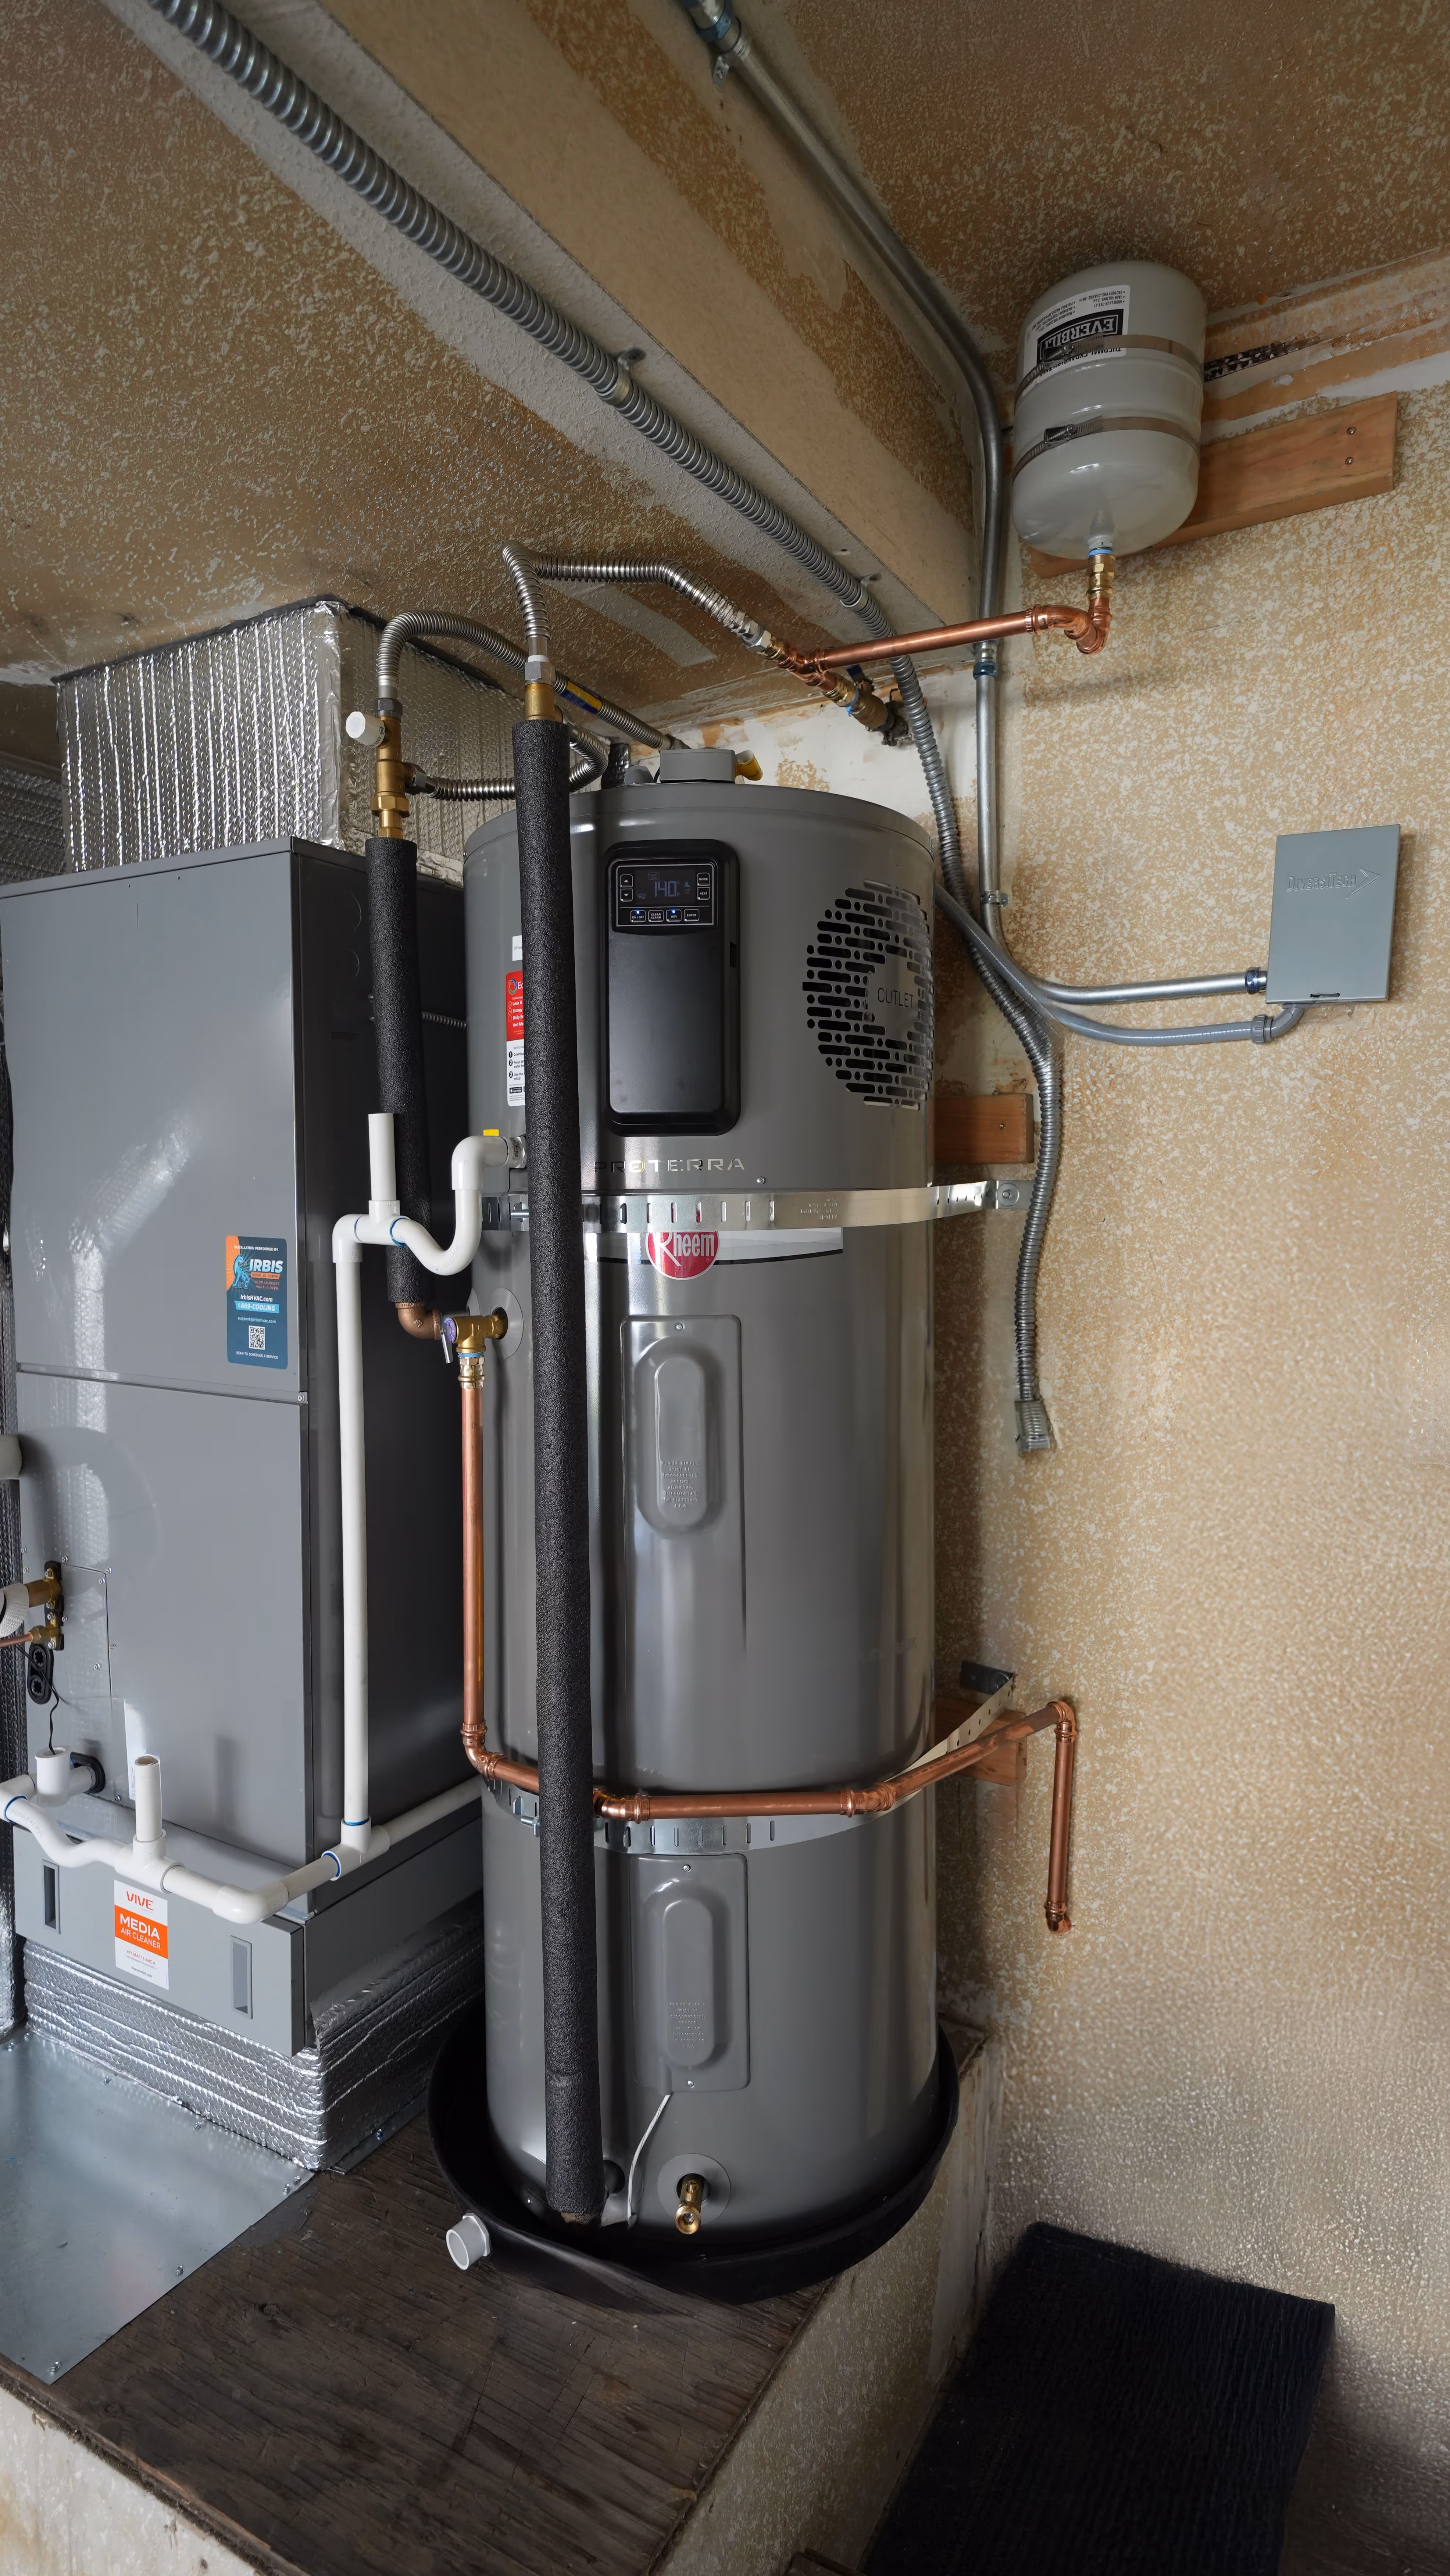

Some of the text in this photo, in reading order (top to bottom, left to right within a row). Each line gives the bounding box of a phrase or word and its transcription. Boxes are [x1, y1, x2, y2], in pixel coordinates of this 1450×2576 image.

[1061, 302, 1073, 310] POTABLE
[654, 881, 677, 897] 140
[877, 987, 914, 1008] OUTLET
[594, 1158, 745, 1172] PROTERRA
[657, 1231, 715, 1267] Rheem
[249, 1259, 283, 1273] IRBIS
[241, 1303, 275, 1311] 669-COOLING
[36, 1825, 44, 1838] PVC
[126, 1890, 154, 1911] VIVE
[120, 1913, 160, 1940] MEDIA
[121, 1927, 161, 1950] AIR CLEANER
